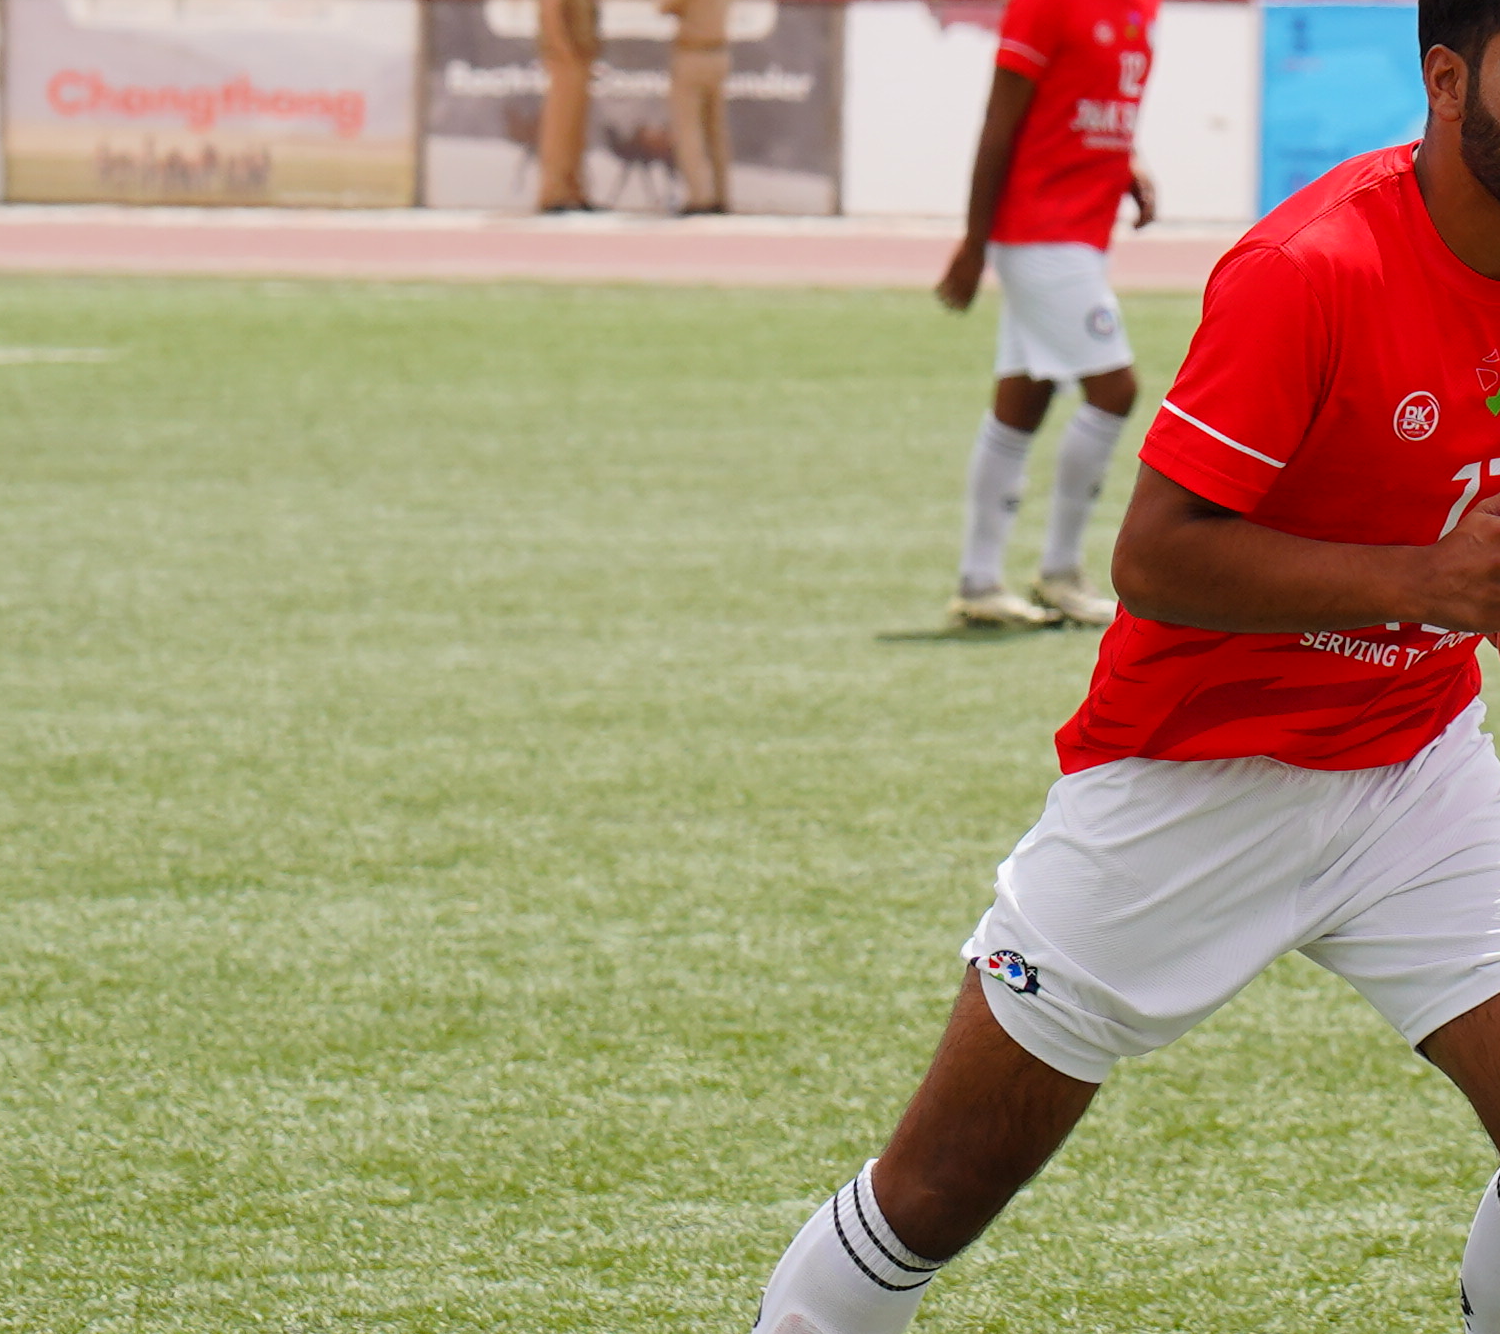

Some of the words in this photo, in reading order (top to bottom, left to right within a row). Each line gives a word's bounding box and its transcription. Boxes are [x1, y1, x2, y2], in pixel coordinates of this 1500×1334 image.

[45, 68, 367, 140] Changthang
[1402, 405, 1433, 431] BK
[1300, 630, 1400, 668] SERVING
